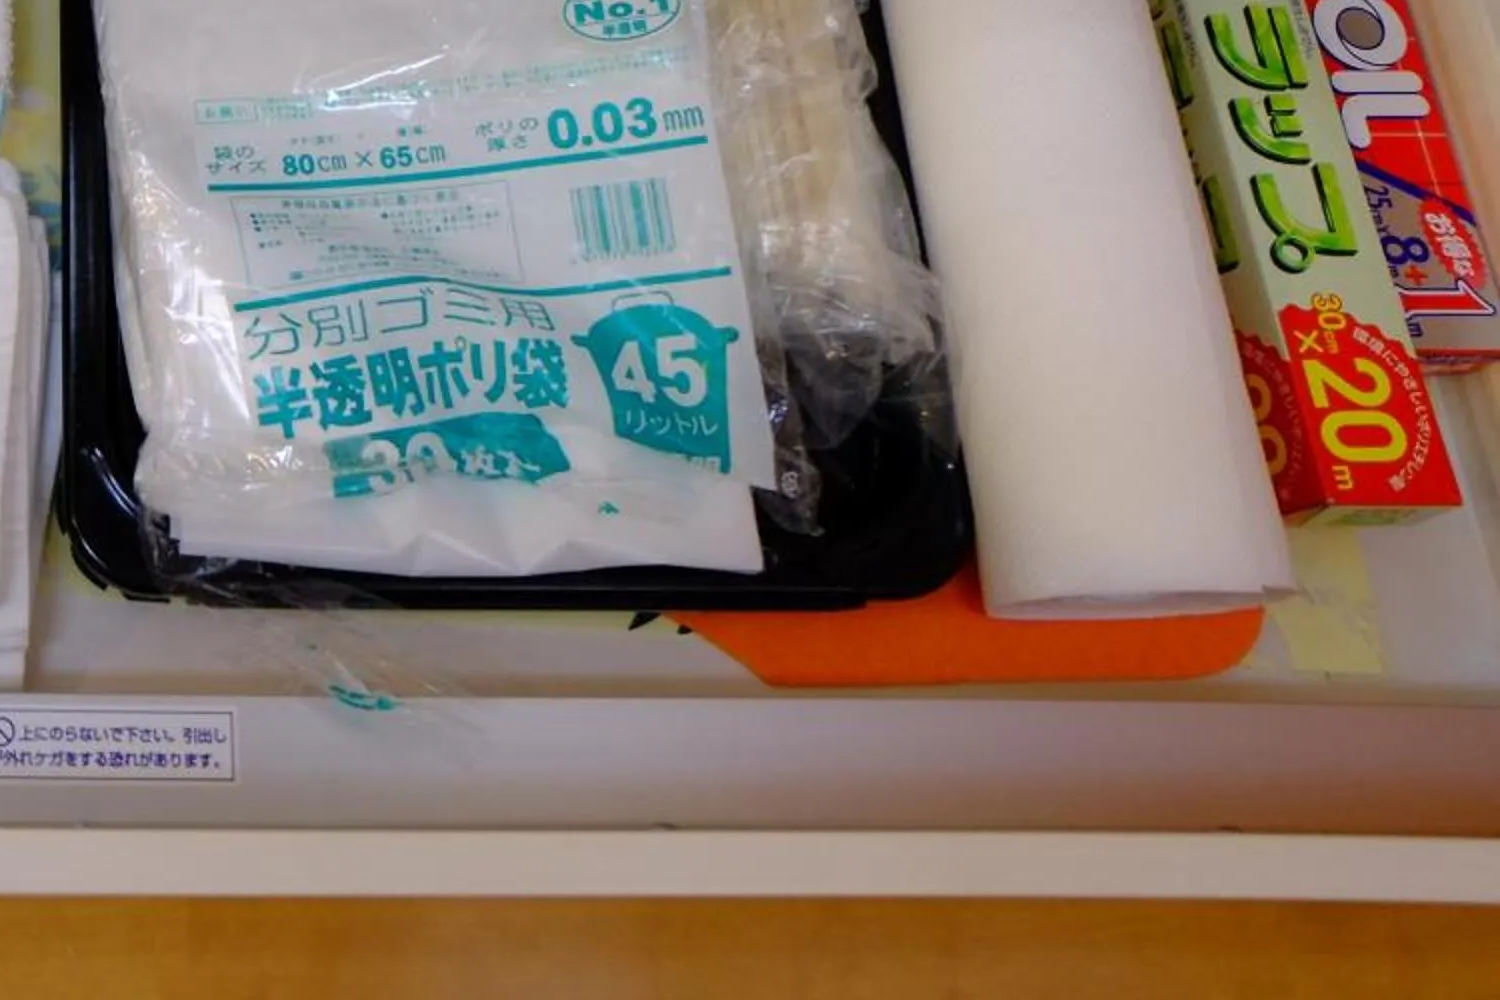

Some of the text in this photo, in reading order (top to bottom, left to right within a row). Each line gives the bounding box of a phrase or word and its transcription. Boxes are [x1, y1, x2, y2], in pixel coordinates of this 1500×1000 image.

[547, 97, 705, 149] 0.03mm
[282, 151, 348, 177] 80cm
[379, 143, 448, 169] 65cm
[244, 286, 558, 361] 分別ゴミ用
[1311, 292, 1347, 354] 30cm
[253, 334, 571, 440] 半透明ポリ袋
[611, 333, 707, 408] 45
[625, 409, 719, 437] リットル
